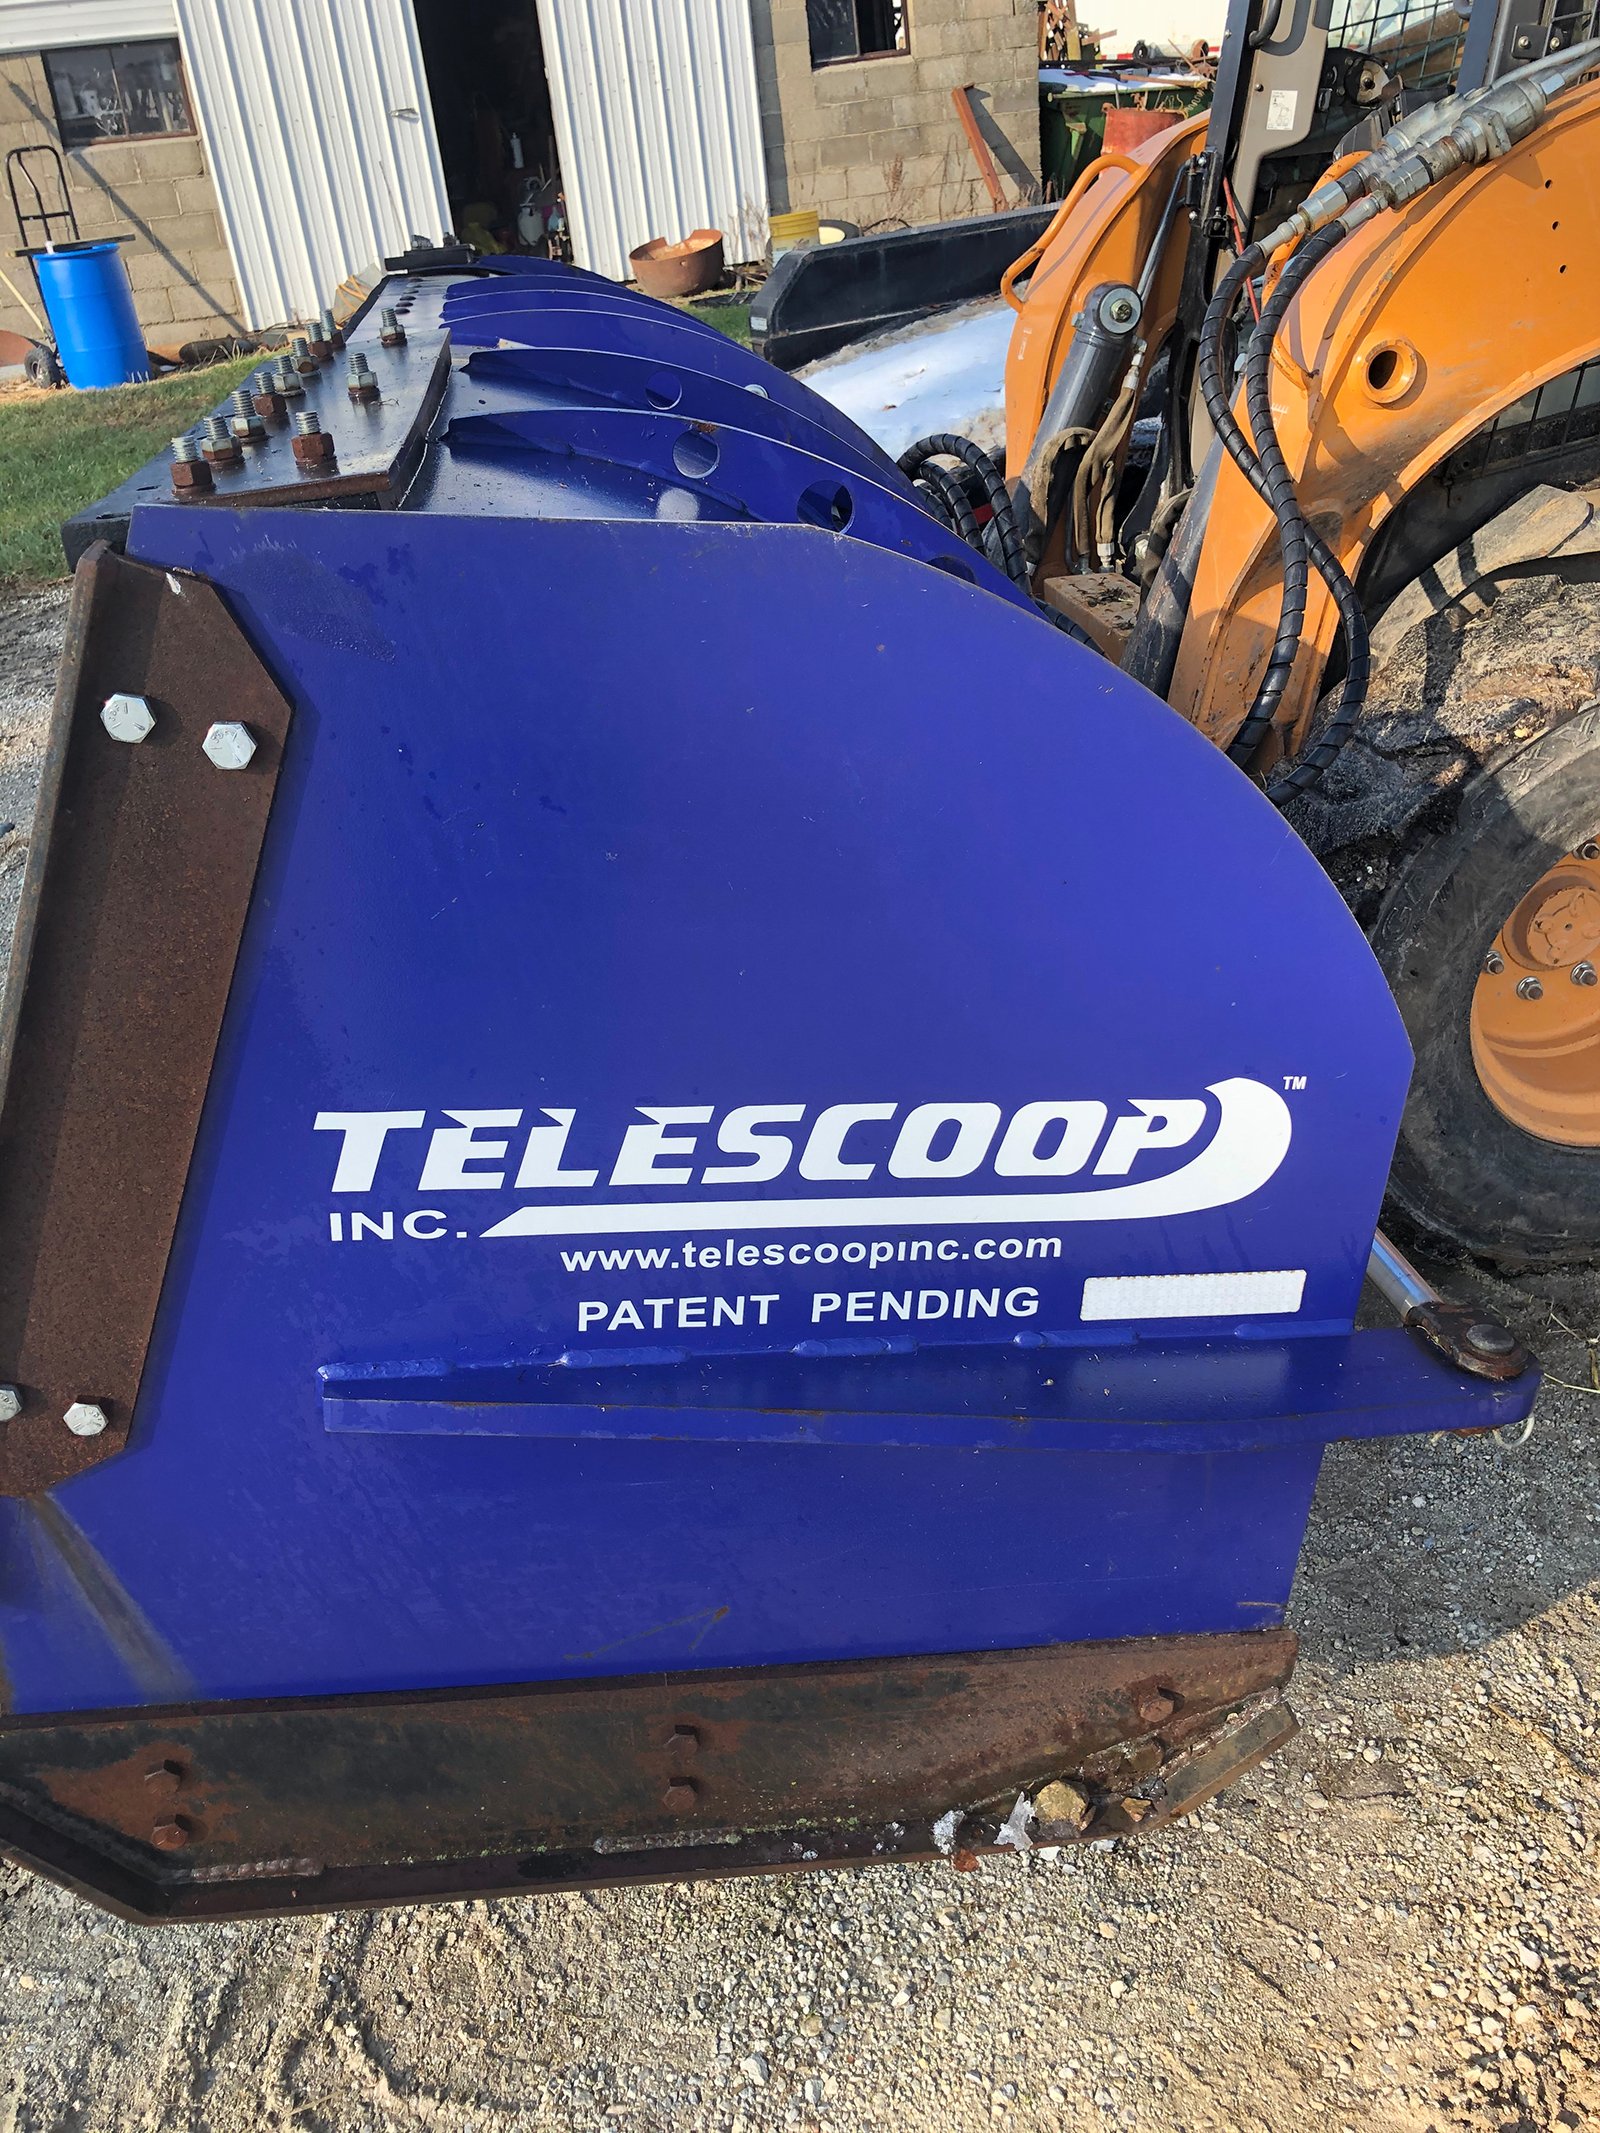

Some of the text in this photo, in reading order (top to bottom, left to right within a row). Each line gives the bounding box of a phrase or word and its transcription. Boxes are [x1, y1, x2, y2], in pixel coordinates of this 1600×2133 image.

[314, 1099, 1208, 1192] TELESCOOP
[329, 1210, 468, 1242] INC.
[560, 1236, 1062, 1272] www.telescoopinc.com
[578, 1286, 1039, 1332] PATENT PENDING
